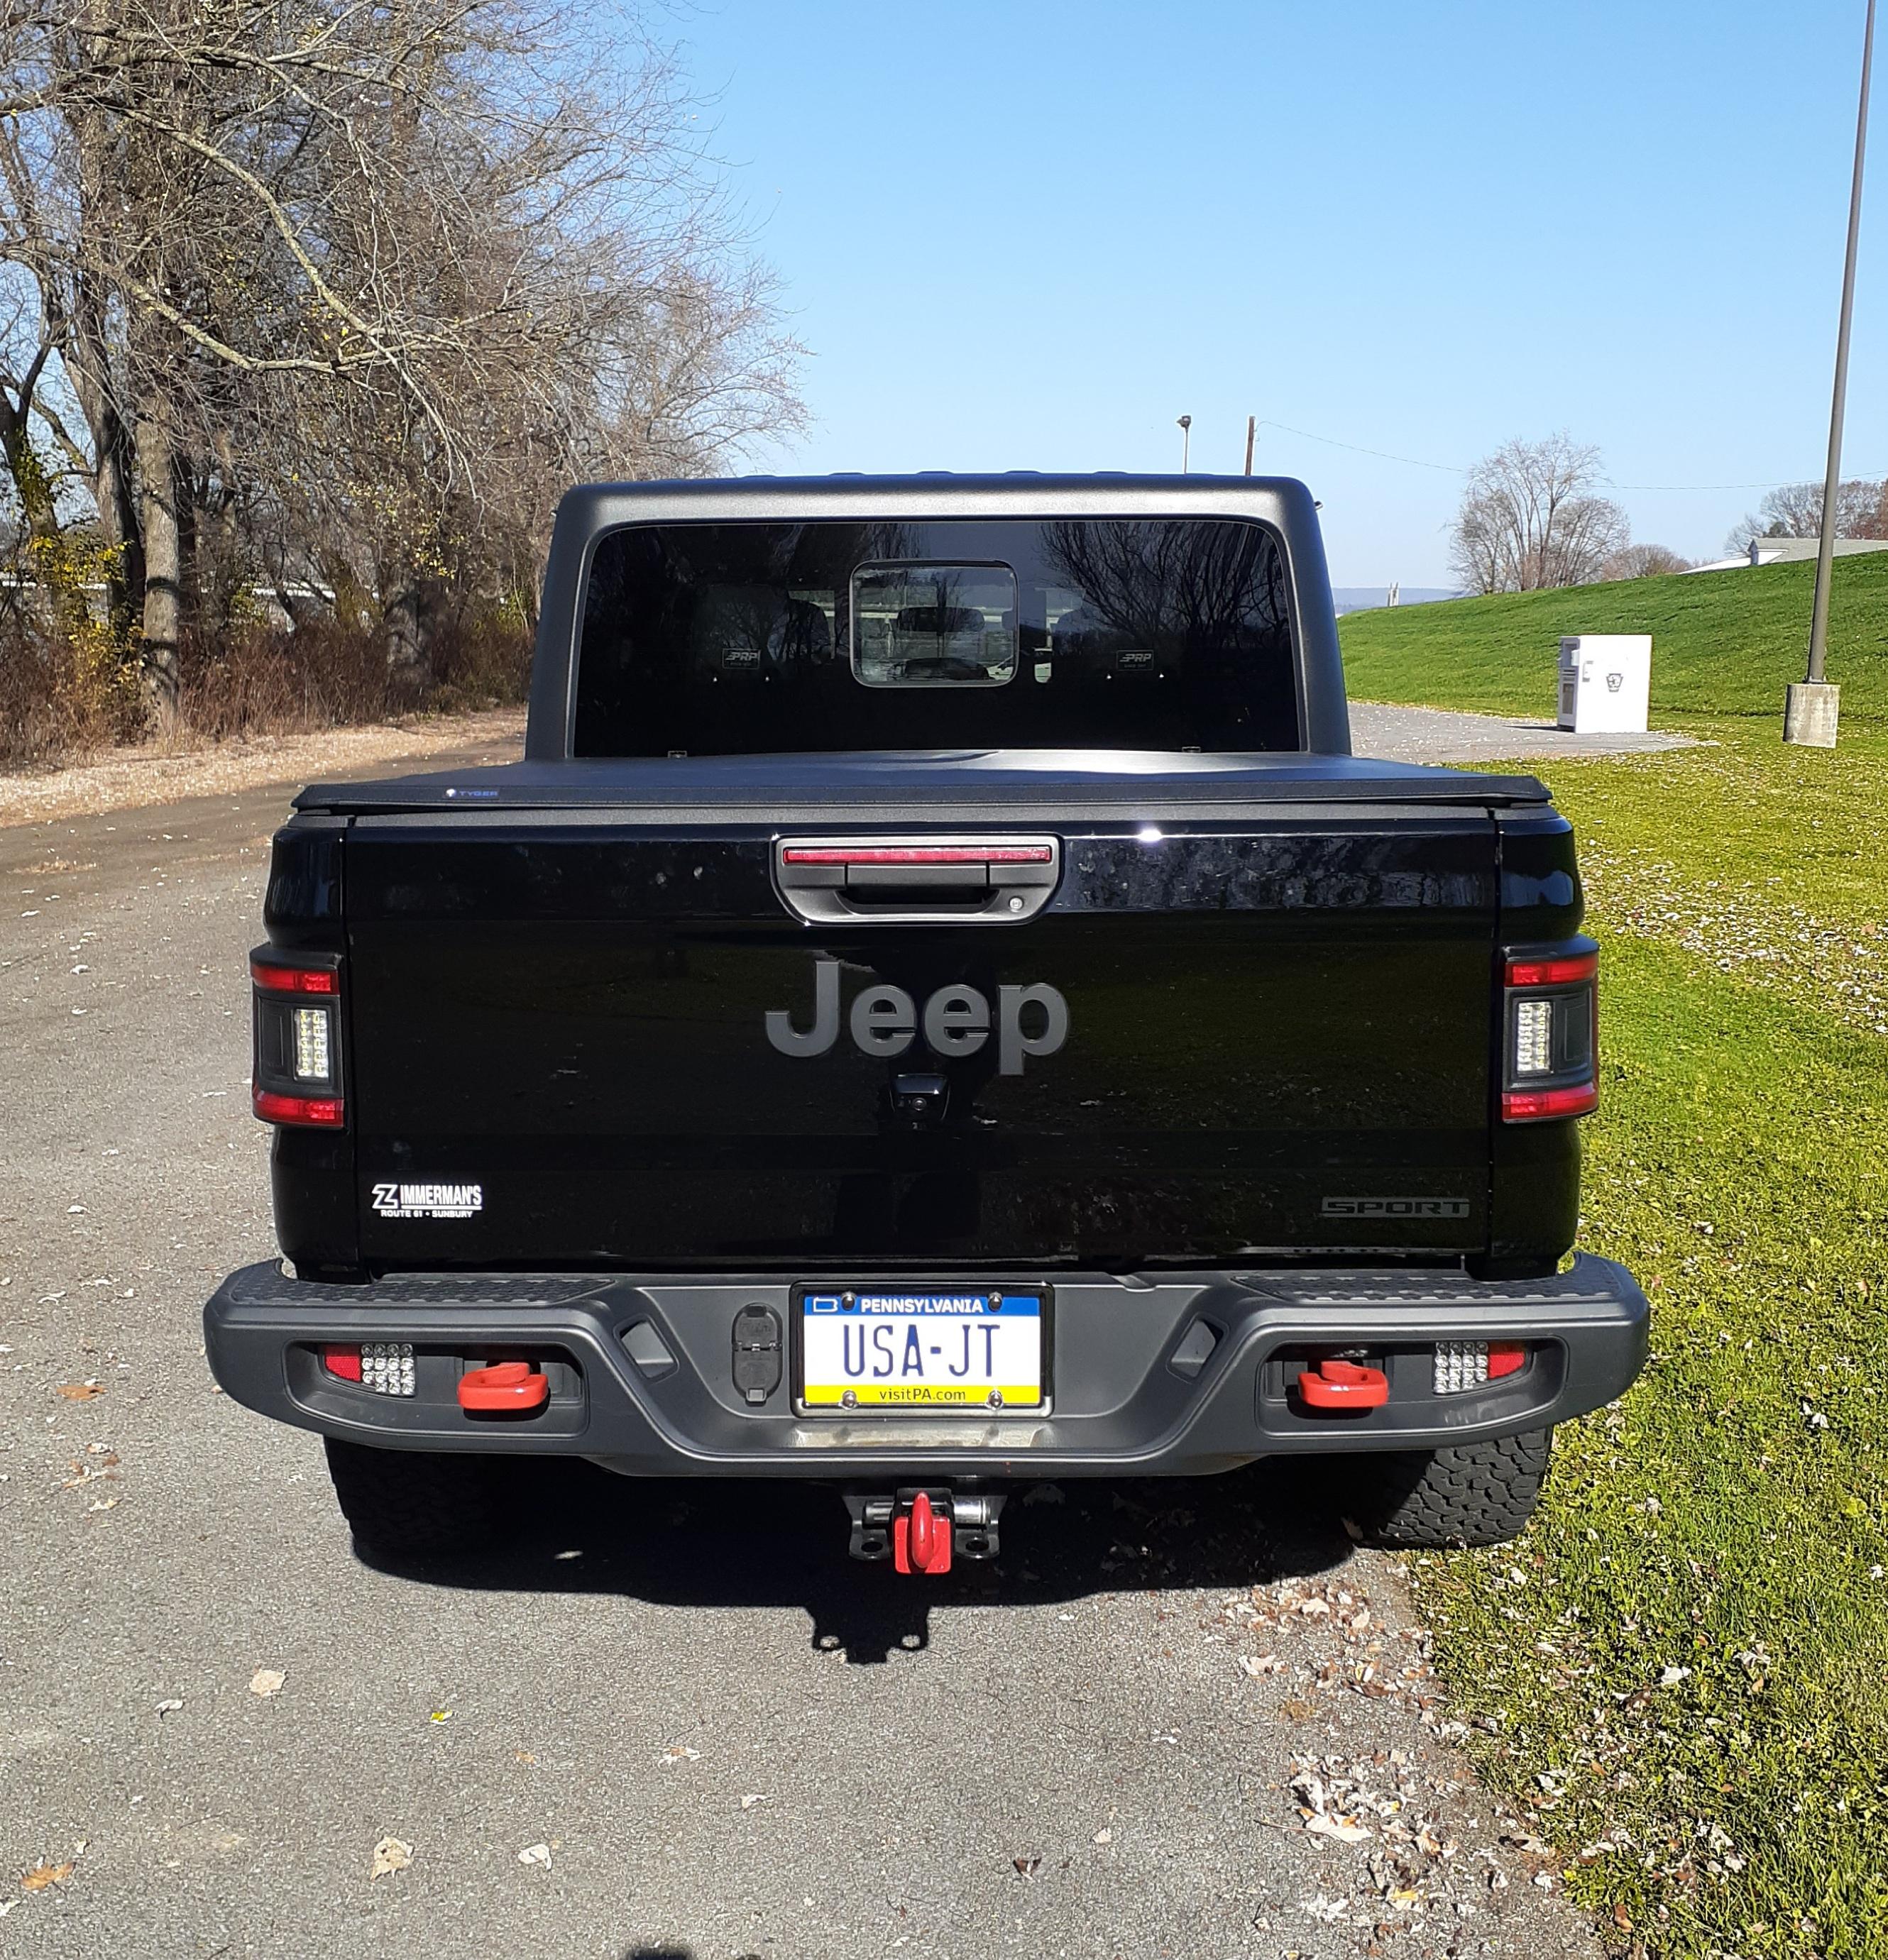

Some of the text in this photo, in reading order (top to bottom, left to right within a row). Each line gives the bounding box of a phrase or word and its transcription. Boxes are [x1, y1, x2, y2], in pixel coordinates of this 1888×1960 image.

[765, 961, 1069, 1076] Jeep
[1322, 1201, 1469, 1214] SPORT
[861, 1298, 983, 1313] PENNSYLVANIA
[843, 1324, 1001, 1377] USA-JT
[879, 1388, 966, 1401] visitPA.com
